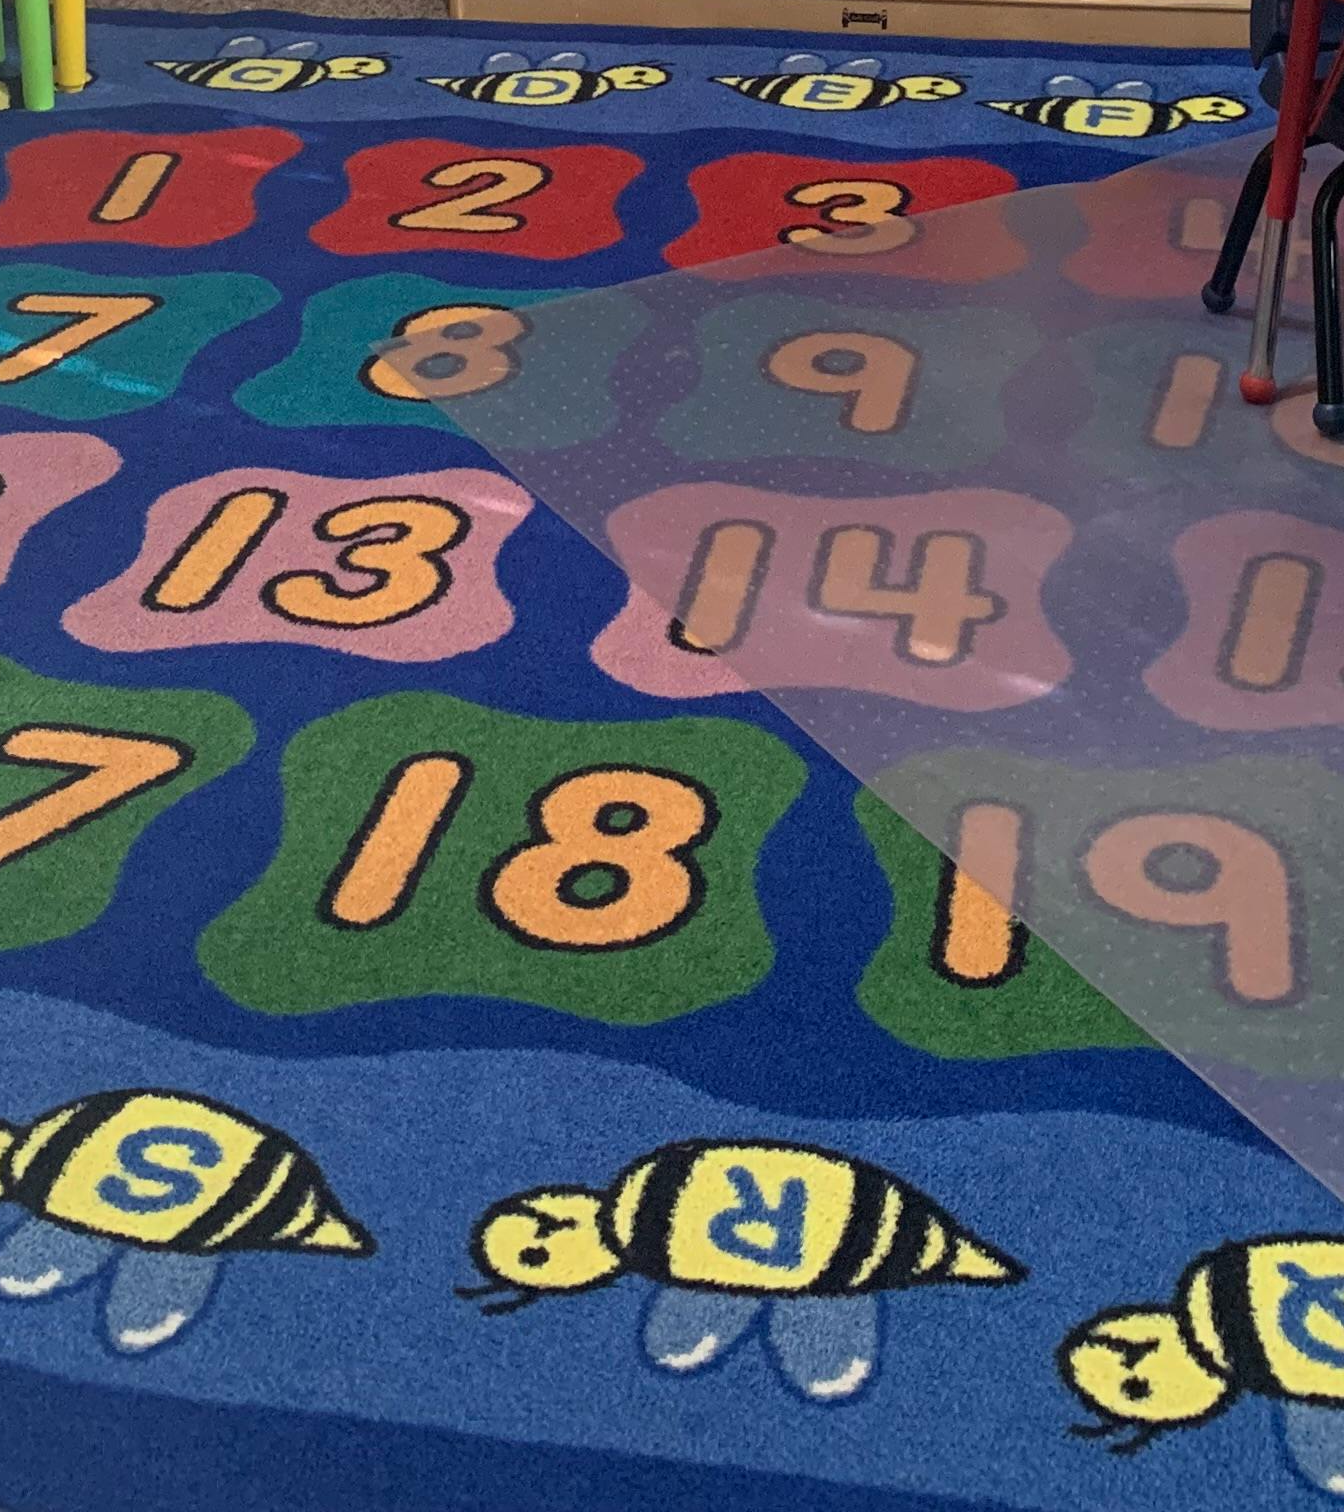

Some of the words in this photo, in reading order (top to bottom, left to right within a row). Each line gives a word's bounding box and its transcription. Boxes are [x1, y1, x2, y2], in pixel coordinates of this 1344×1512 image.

[229, 65, 284, 86] C
[508, 76, 570, 98] D
[803, 78, 859, 104] E
[1084, 104, 1137, 128] F
[88, 150, 182, 224] 1
[387, 158, 553, 233] 2
[778, 177, 924, 256] 3
[358, 301, 533, 403] 8
[761, 329, 926, 435] 9
[140, 485, 473, 631] 13
[665, 517, 1010, 665] 14
[318, 749, 722, 953] 18
[929, 798, 1308, 1008] 19
[96, 1125, 224, 1215] S
[705, 1164, 810, 1271] R
